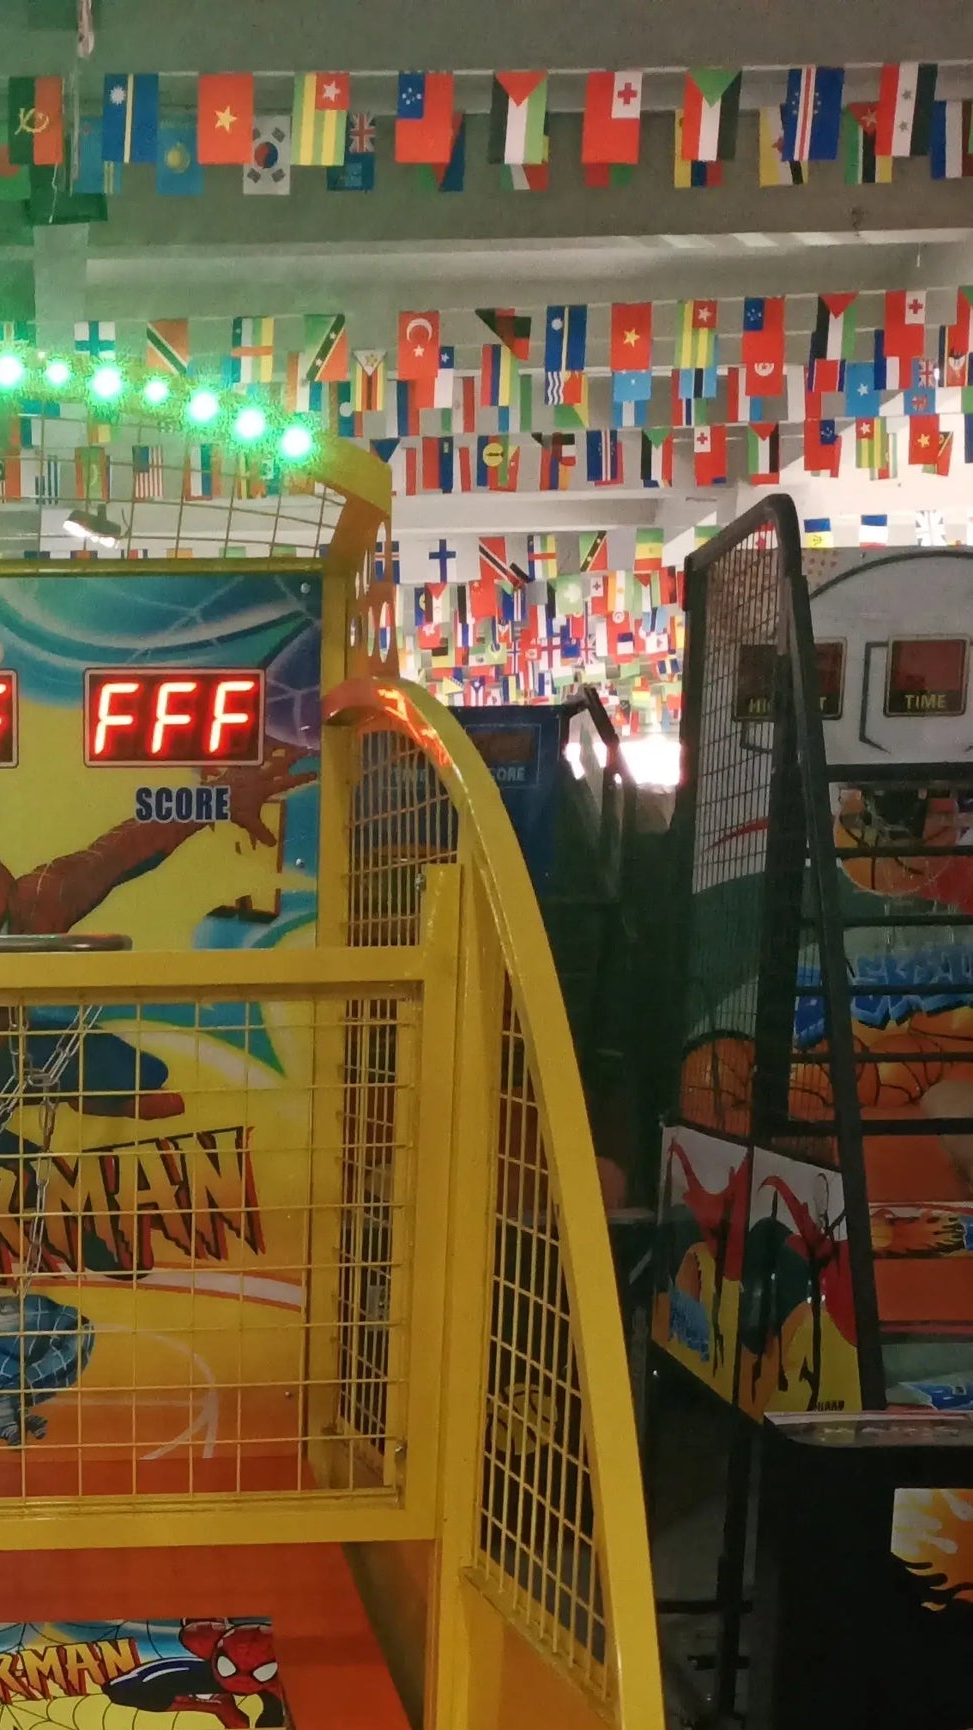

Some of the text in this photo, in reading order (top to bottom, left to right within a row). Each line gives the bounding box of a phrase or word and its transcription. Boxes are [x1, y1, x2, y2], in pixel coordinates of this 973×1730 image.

[94, 681, 255, 754] FFF
[905, 694, 948, 711] TIME
[135, 787, 231, 822] SCORE
